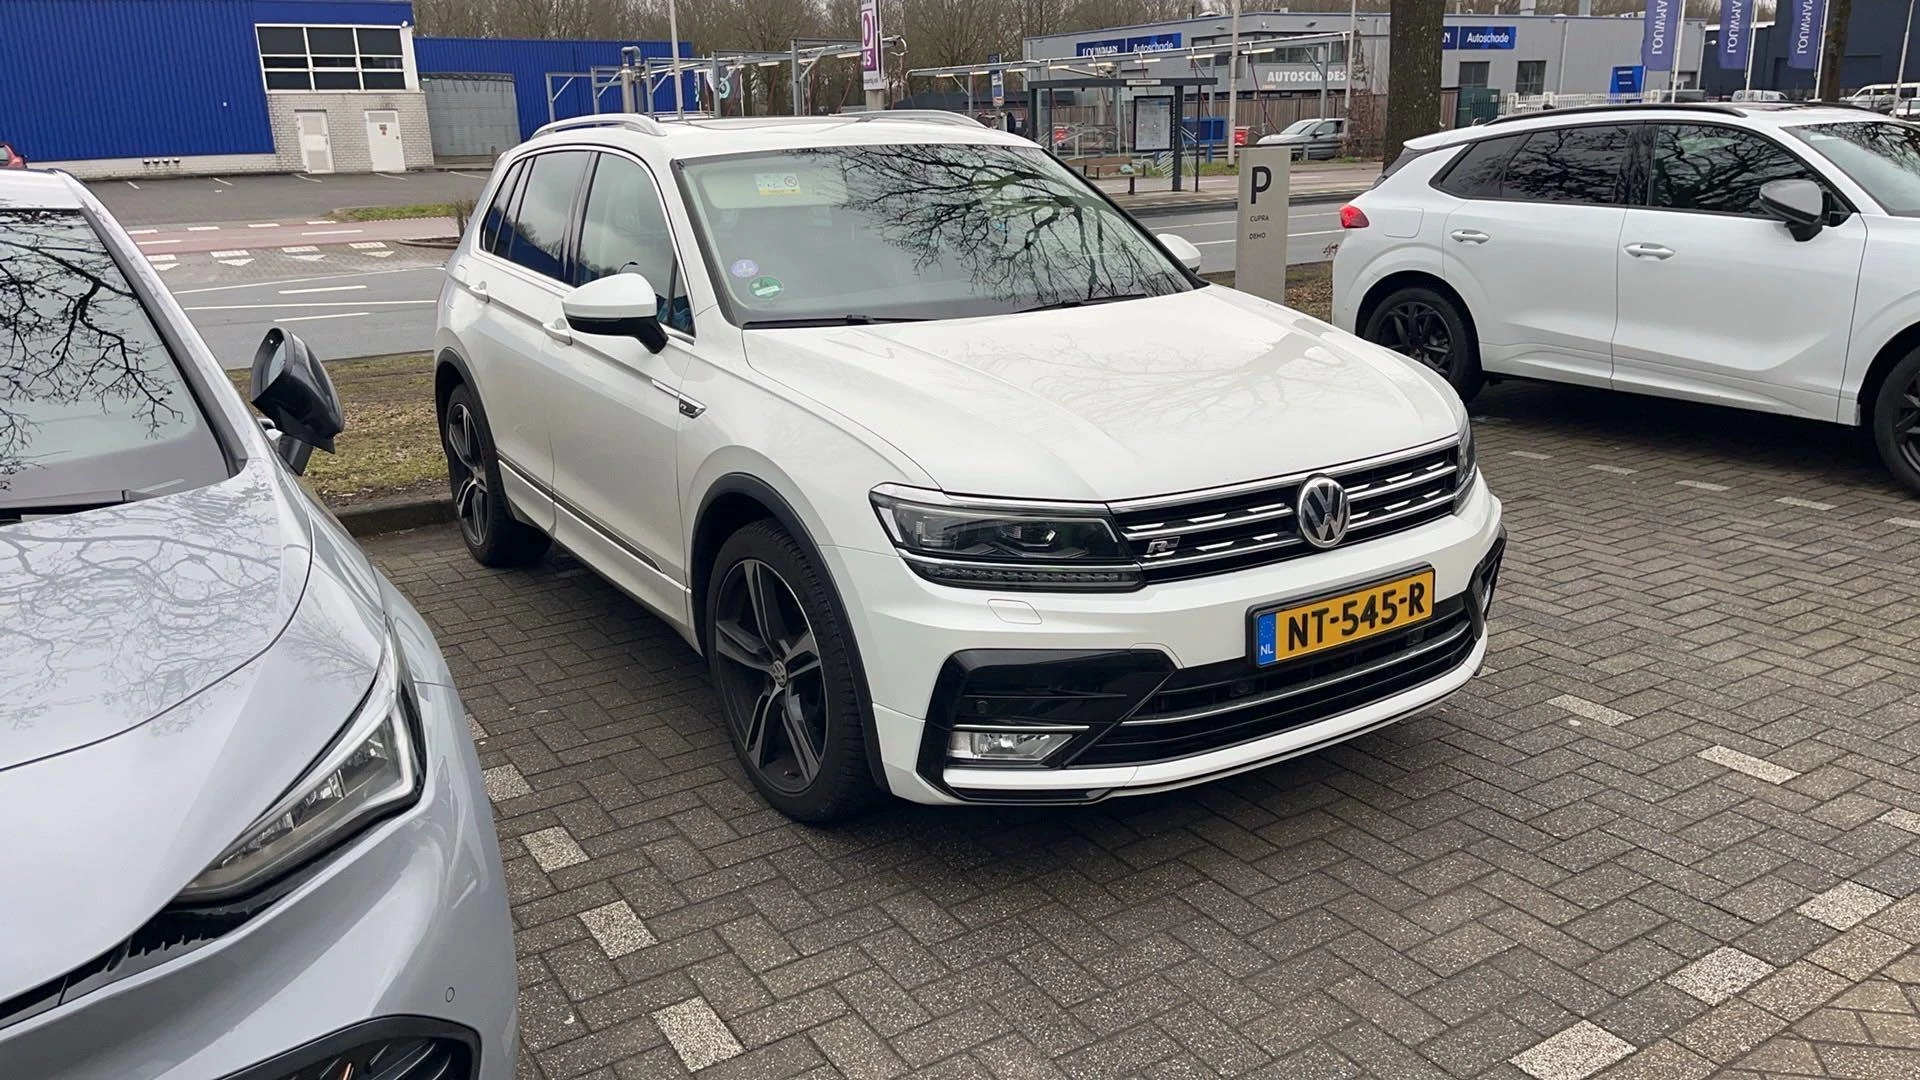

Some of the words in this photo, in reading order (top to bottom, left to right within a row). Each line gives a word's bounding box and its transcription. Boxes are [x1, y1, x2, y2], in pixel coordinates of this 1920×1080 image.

[1466, 32, 1510, 43] Autoschade
[1250, 165, 1272, 204] P
[1249, 215, 1270, 223] CUPRA
[1248, 232, 1266, 240] DEMO
[1299, 476, 1350, 548] VW
[1288, 581, 1425, 651] NT-545-R
[1260, 643, 1274, 656] NL
